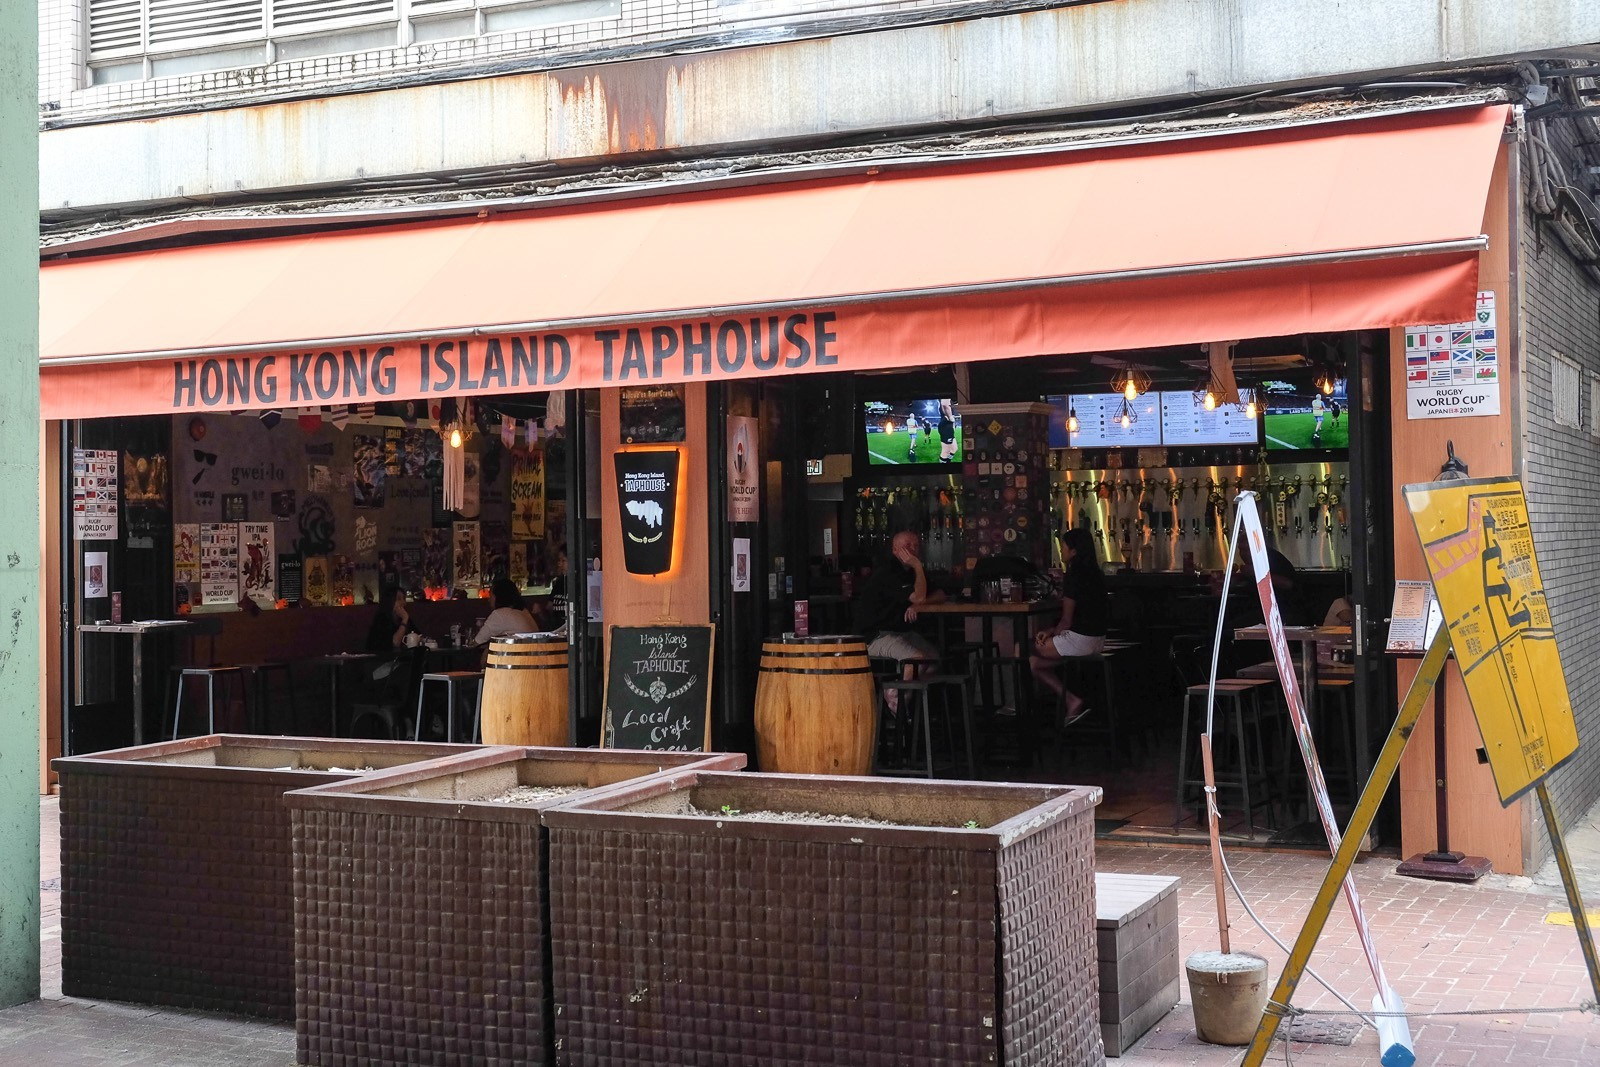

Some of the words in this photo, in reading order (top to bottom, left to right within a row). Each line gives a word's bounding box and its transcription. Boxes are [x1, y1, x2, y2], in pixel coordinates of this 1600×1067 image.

[173, 356, 277, 407] HONG
[289, 346, 396, 401] KONG
[419, 334, 571, 392] ISLAND
[595, 312, 838, 381] TAPHOUSE
[1436, 388, 1464, 396] RUGBY
[1416, 397, 1460, 407] WORLD
[512, 479, 542, 500] SCREAM
[624, 479, 666, 492] TAPHOUSE
[358, 526, 377, 540] LION
[356, 537, 376, 551] ROCK
[640, 634, 664, 650] Hong
[664, 632, 688, 648] Kong
[648, 647, 679, 659] Island
[632, 660, 690, 674] TAPHOUSE
[622, 706, 671, 728] Local
[650, 715, 691, 742] Craft
